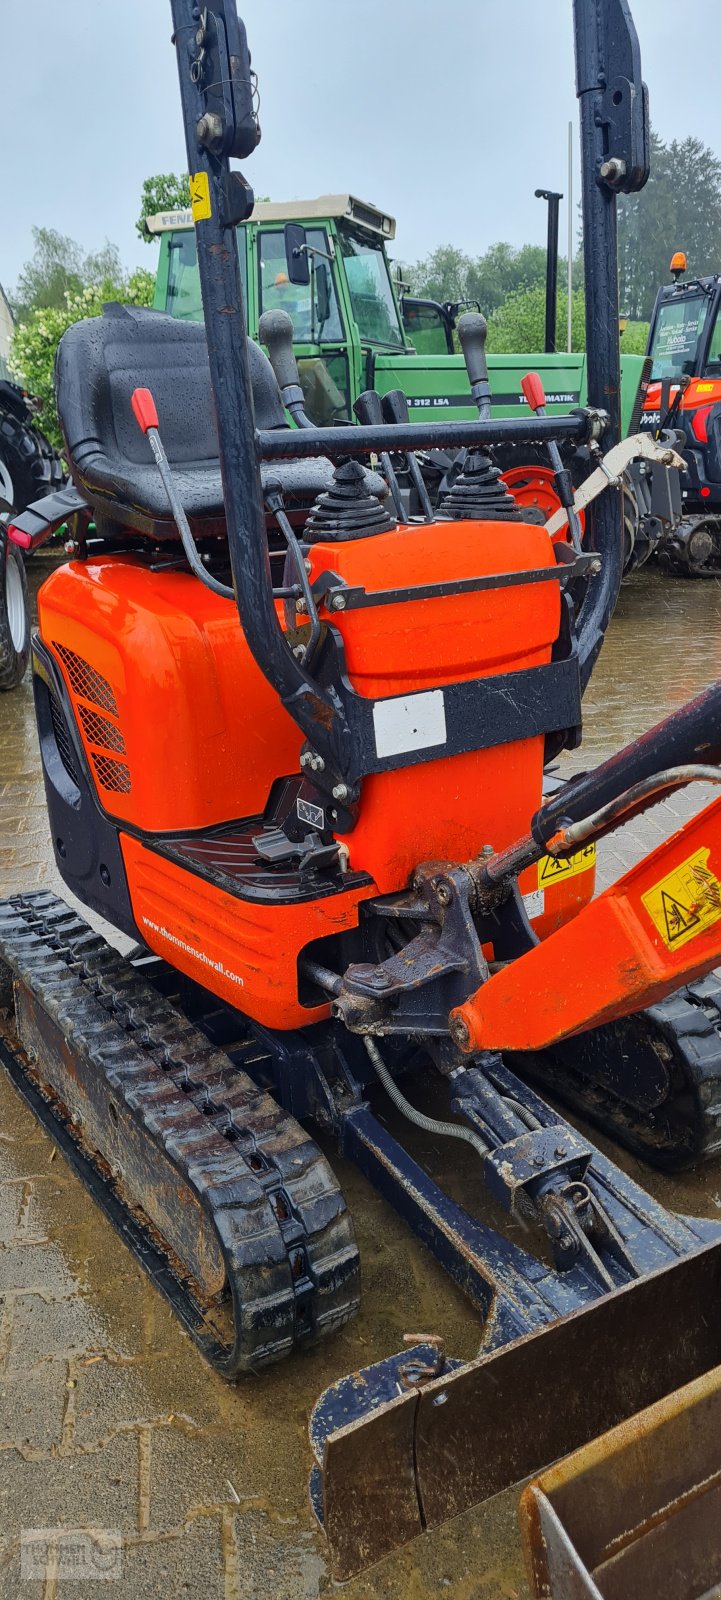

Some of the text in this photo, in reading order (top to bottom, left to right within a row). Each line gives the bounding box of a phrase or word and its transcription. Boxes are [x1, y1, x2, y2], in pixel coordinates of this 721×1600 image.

[162, 213, 192, 225] FEND
[414, 398, 431, 407] 312
[433, 398, 450, 406] LSA
[141, 915, 244, 987] www.thommenschwall.com
